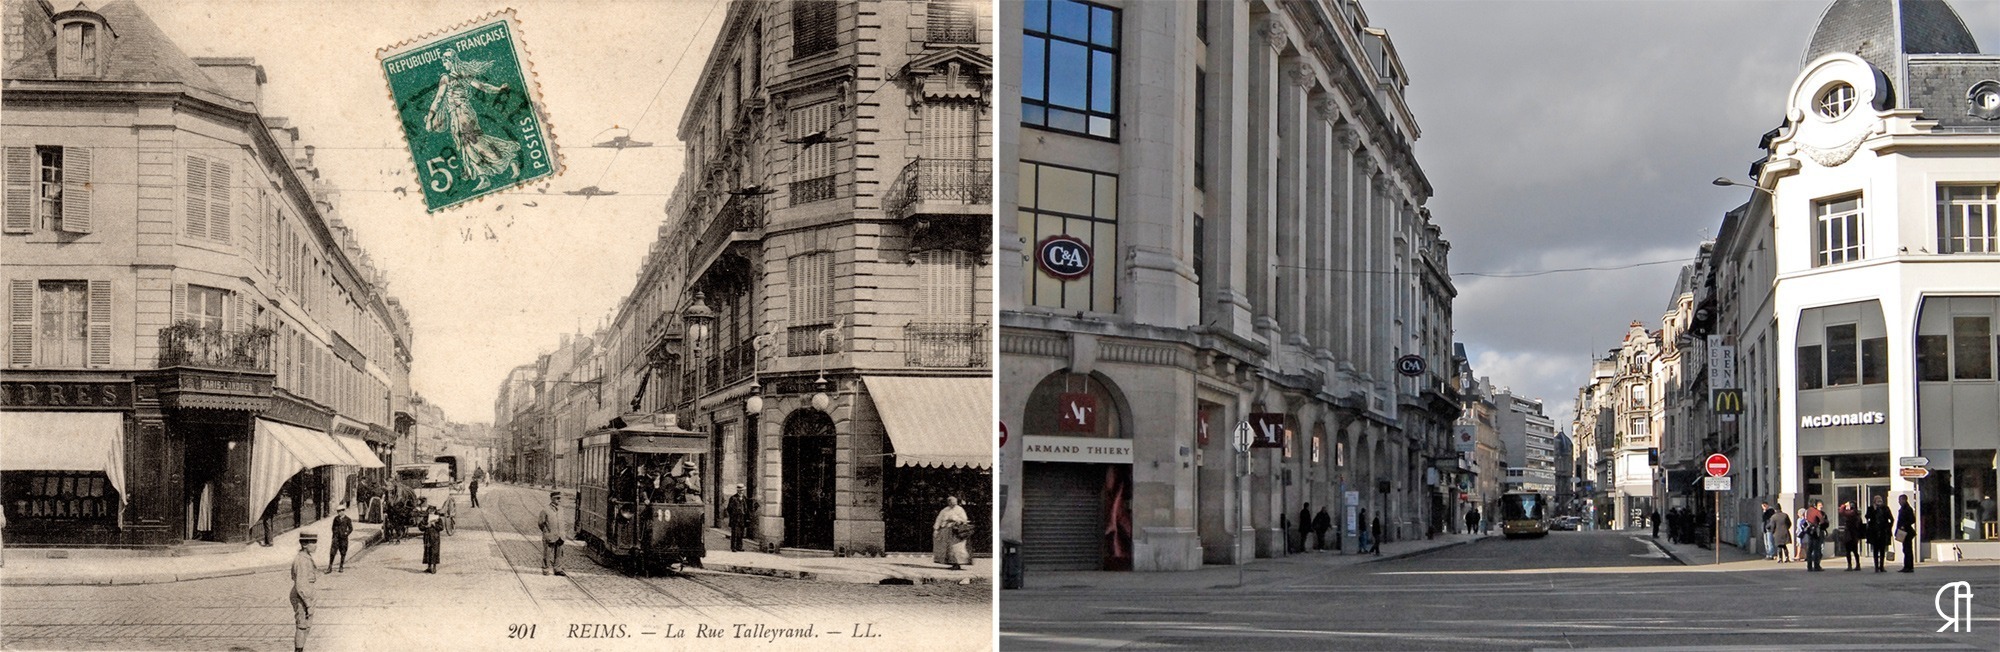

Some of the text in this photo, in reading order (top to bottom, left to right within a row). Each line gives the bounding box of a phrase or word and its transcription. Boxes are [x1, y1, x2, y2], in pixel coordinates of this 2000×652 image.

[456, 28, 506, 53] FRANÇAISE
[520, 116, 545, 169] POSTES
[1049, 246, 1084, 268] C&A
[1402, 359, 1421, 371] C&A
[1710, 338, 1719, 387] MEUBL
[201, 379, 253, 391] PARIS-LONDRES
[1801, 411, 1885, 428] McDonald's
[1026, 444, 1131, 456] ARMAND THIERY
